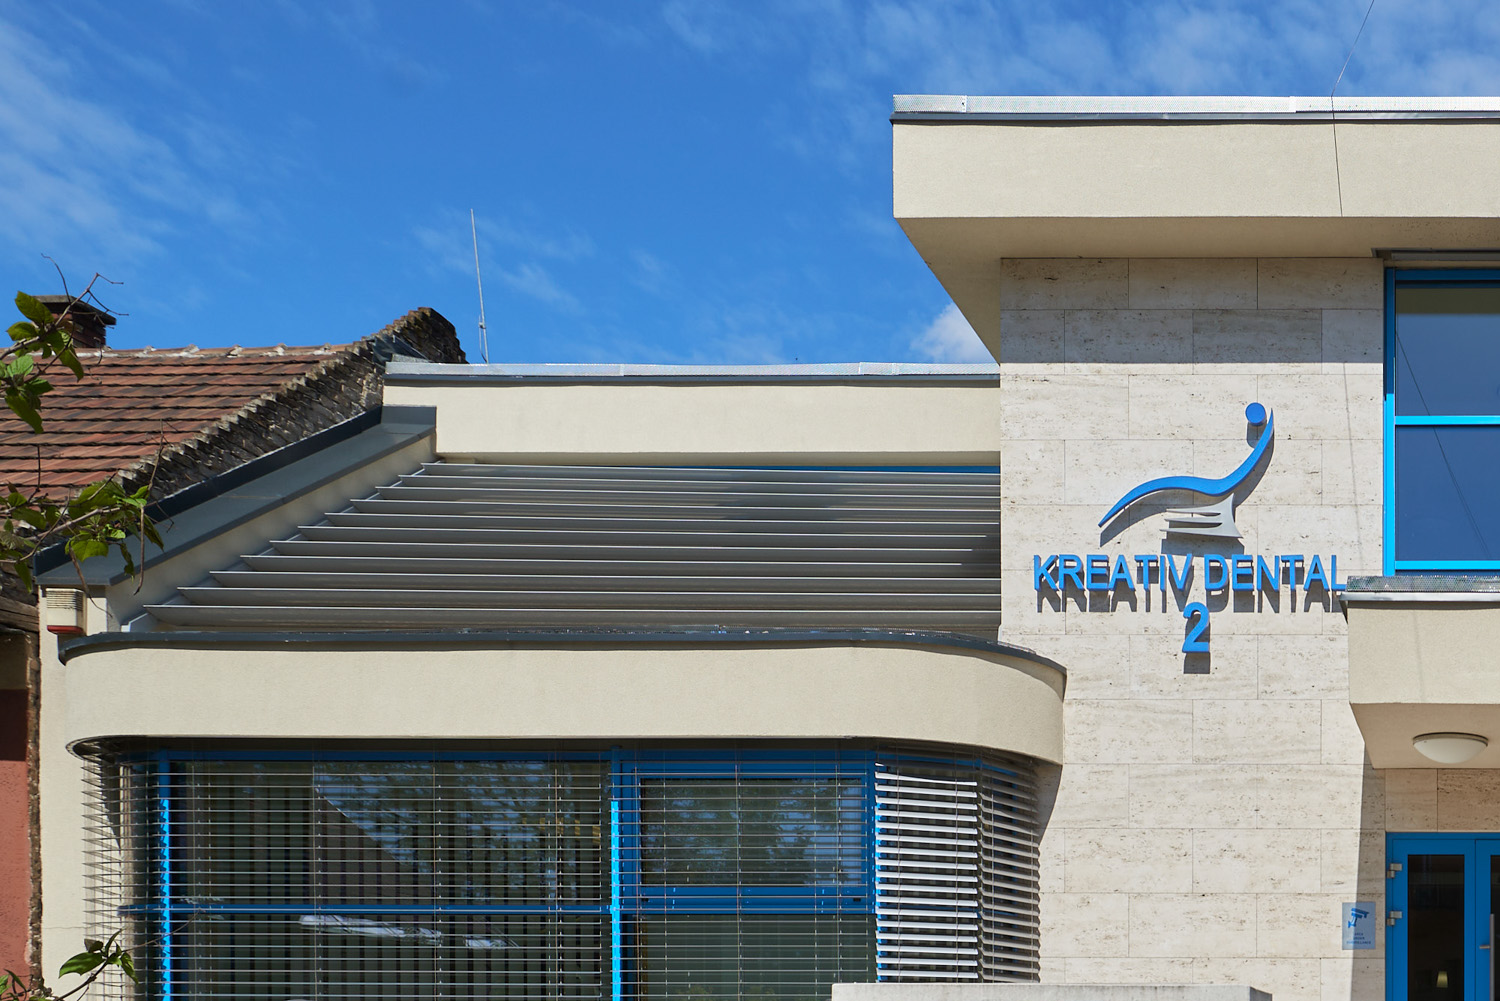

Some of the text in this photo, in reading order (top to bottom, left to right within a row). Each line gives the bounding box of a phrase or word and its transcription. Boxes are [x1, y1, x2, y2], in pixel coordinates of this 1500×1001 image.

[1033, 554, 1347, 592] KREATIV DENTAL
[1182, 602, 1210, 653] 2
